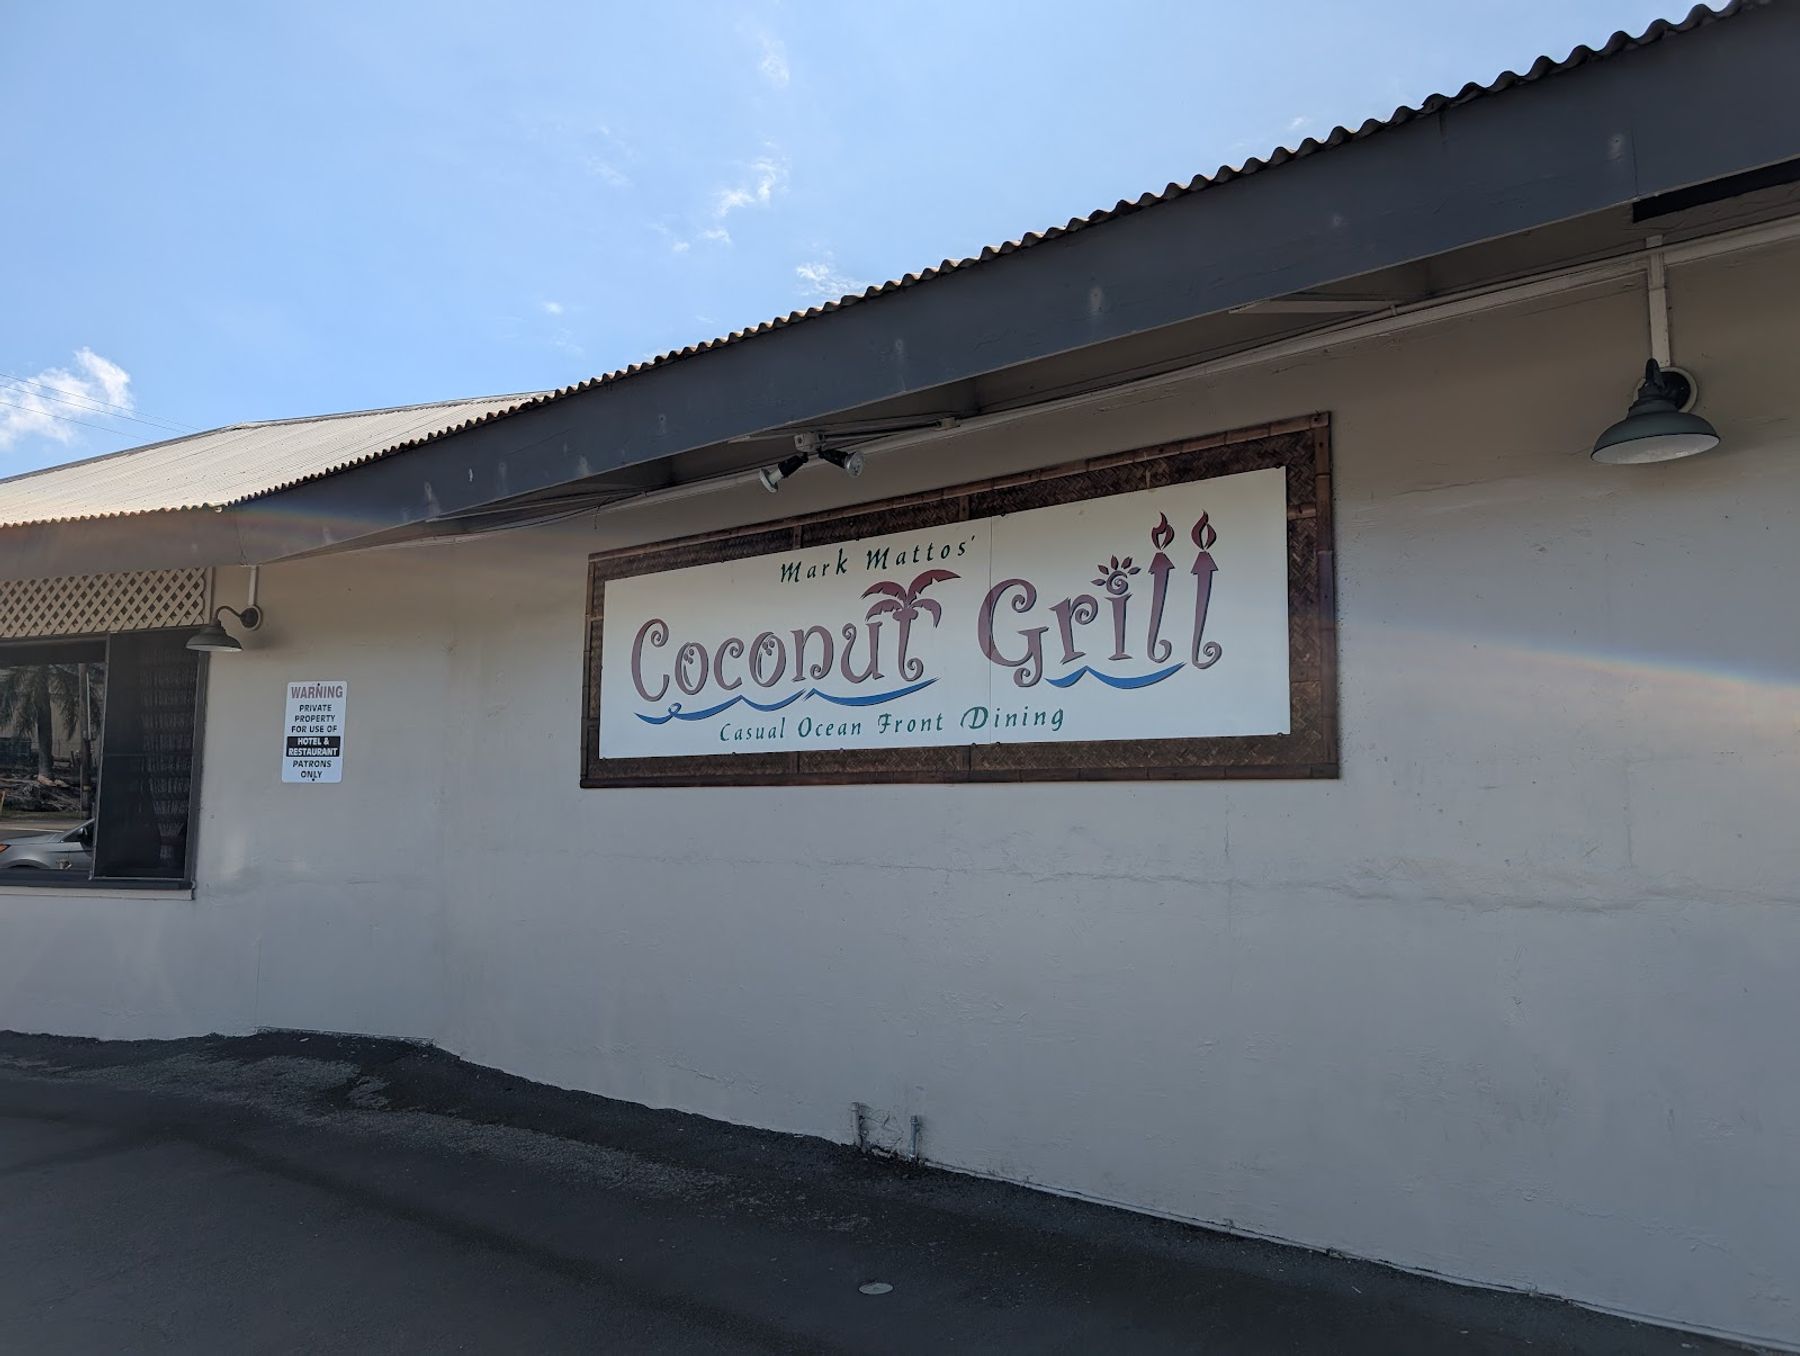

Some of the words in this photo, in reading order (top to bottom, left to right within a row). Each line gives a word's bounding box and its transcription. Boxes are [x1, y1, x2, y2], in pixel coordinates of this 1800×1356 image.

[780, 548, 849, 583] Mark
[866, 535, 976, 571] Mattos'
[631, 569, 960, 702] Coconut
[977, 510, 1223, 688] Grill
[291, 686, 343, 699] WARNING
[299, 704, 332, 712] PRIVATE
[294, 714, 336, 722] PROPERTY
[719, 717, 786, 742] Casual
[798, 716, 862, 738] Ocean
[877, 712, 944, 734] Front
[960, 705, 1064, 731] Dining
[291, 725, 307, 733] FOR
[309, 725, 324, 733] USE
[326, 725, 337, 733] OF
[297, 737, 321, 746] HOTEL
[323, 737, 330, 746] &
[288, 747, 338, 756] RESTAURANT
[292, 760, 332, 768] PATRONS
[300, 770, 323, 779] ONLY
